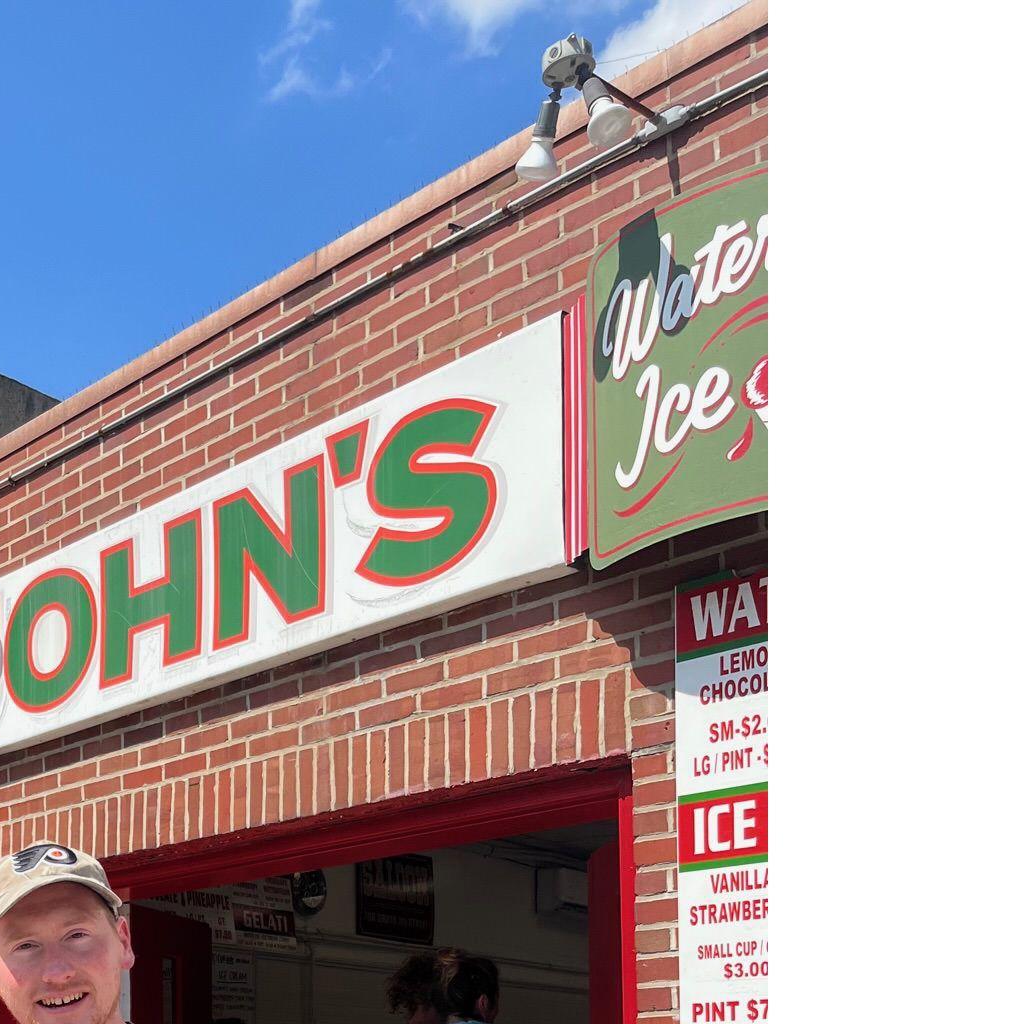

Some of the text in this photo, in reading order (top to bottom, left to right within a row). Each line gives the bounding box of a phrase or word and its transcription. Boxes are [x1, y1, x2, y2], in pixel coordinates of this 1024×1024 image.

[615, 364, 735, 488] Ice
[709, 714, 768, 743] SM-$2.
[693, 755, 711, 777] LG
[722, 747, 753, 772] PINT
[693, 800, 758, 855] ICE
[243, 910, 289, 934] GELATI
[697, 943, 733, 960] SMALL
[736, 940, 758, 957] CUP
[691, 1001, 739, 1023] PINT
